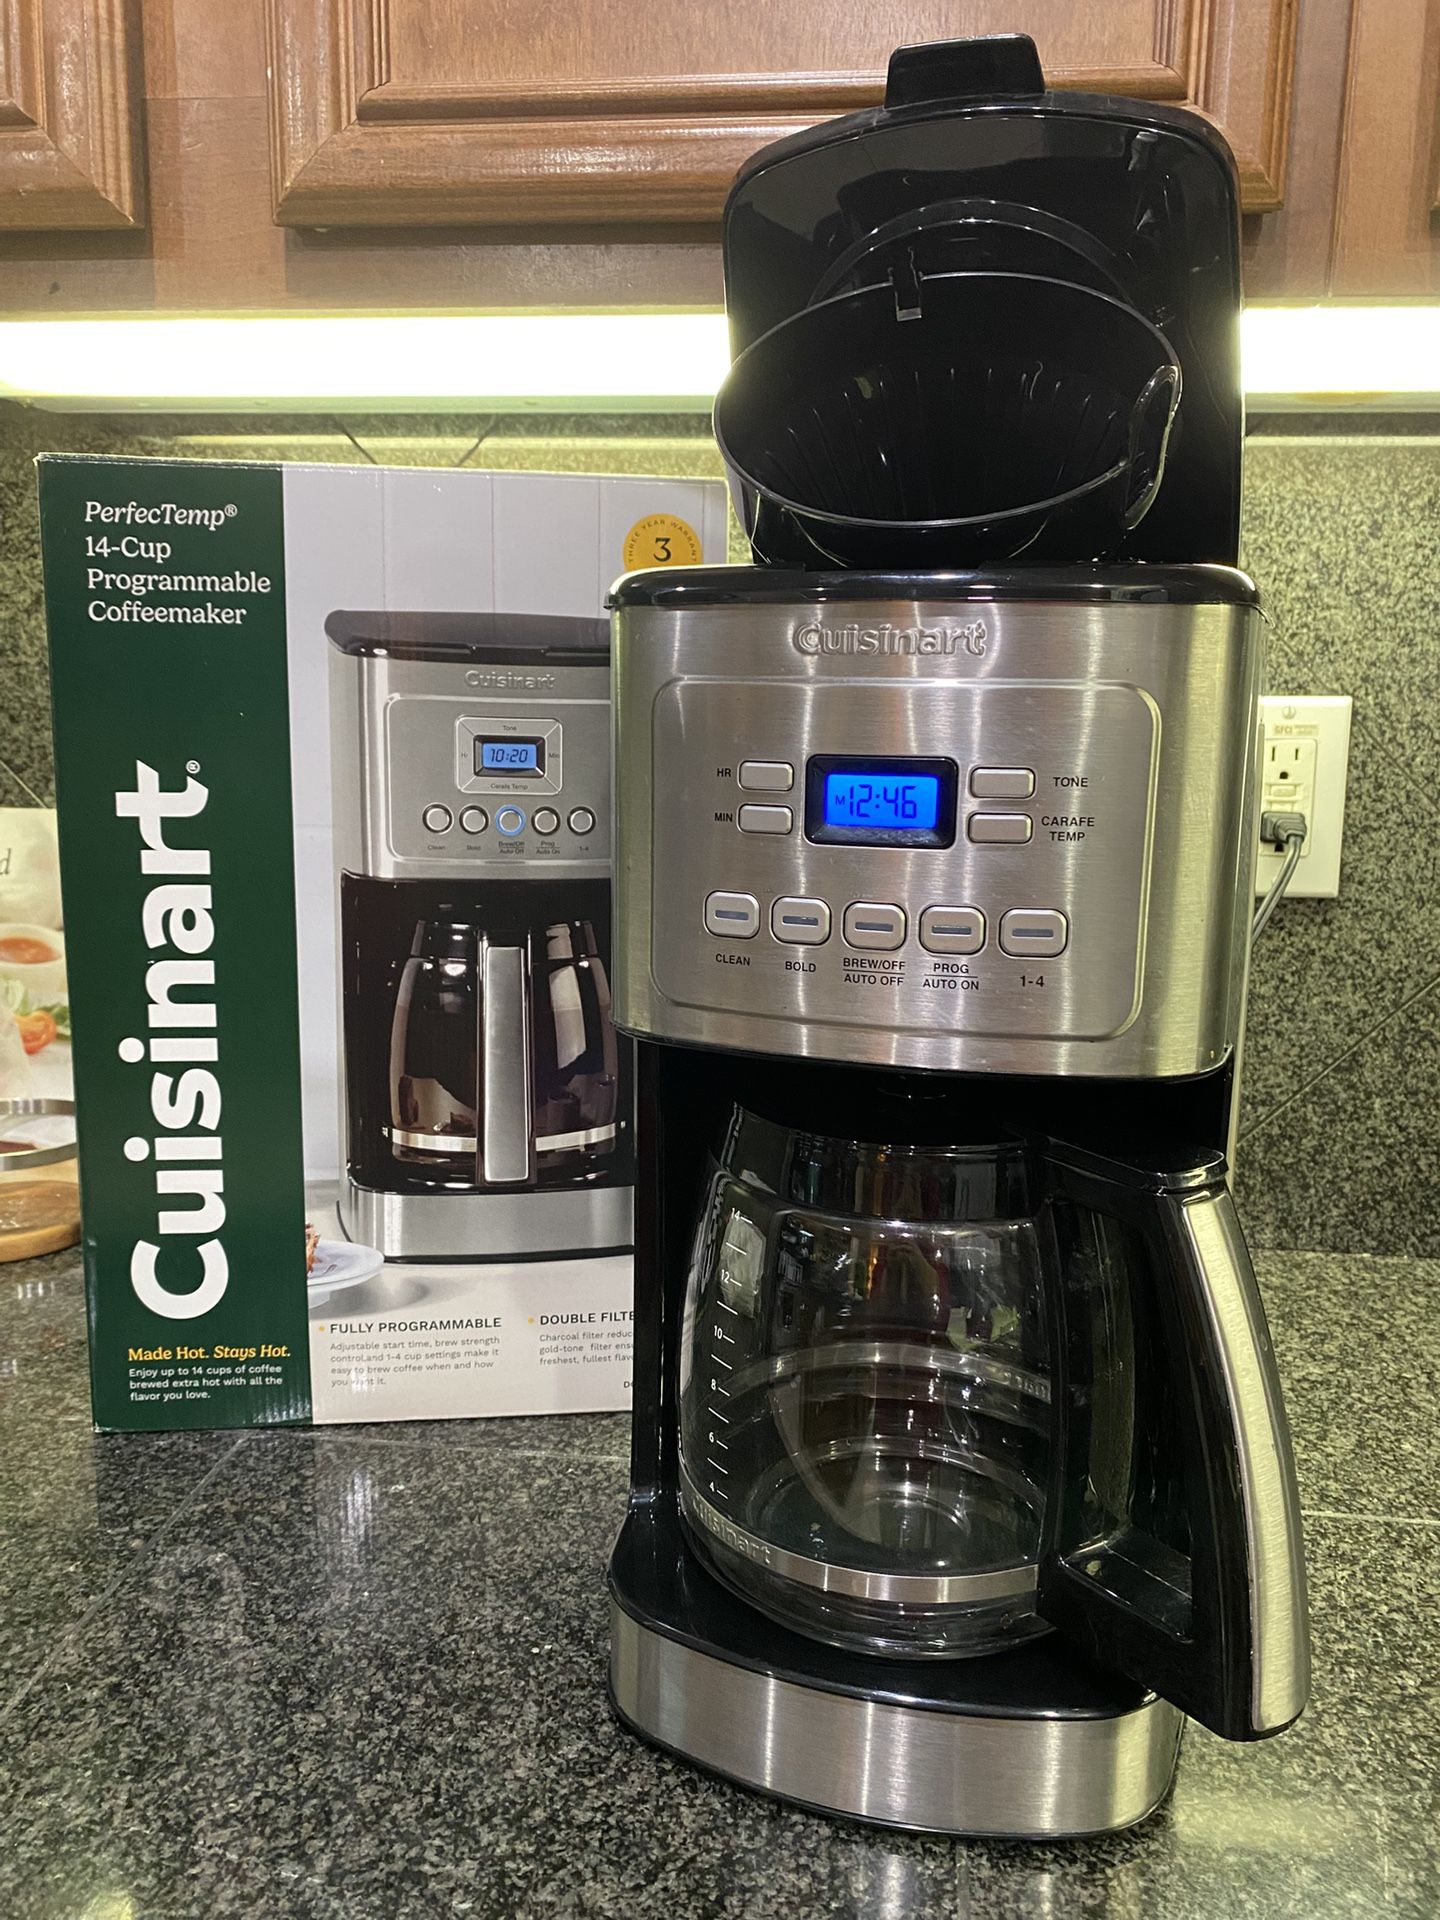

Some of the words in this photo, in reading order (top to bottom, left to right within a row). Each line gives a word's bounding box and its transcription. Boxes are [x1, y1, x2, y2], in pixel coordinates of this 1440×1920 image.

[84, 501, 238, 531] PerfecTemp®
[628, 532, 641, 563] THREE
[642, 519, 666, 530] YEAR
[85, 536, 171, 563] 14-Cup
[653, 537, 672, 562] 3
[87, 568, 271, 595] Programmable
[88, 600, 247, 624] Coffeemaker
[792, 619, 988, 657] Cuisinart
[464, 670, 556, 689] Cuisinart
[490, 748, 528, 763] 10:20
[717, 768, 732, 778] HR
[1053, 776, 1088, 788] TONE
[849, 784, 917, 819] 12:46
[714, 812, 733, 823] MIN
[1041, 816, 1095, 827] CARAFE
[1049, 831, 1085, 842] TEMP
[715, 953, 751, 966] CLEAN
[843, 957, 906, 970] BREW/OFF
[785, 961, 817, 973] BOLD
[933, 963, 969, 974] PROG
[844, 974, 877, 985] AUTO
[880, 976, 904, 986] OFF
[923, 978, 957, 989] AUTO
[961, 979, 979, 991] ON
[1020, 975, 1044, 987] 1-4
[731, 1208, 740, 1221] 14
[721, 1269, 730, 1284] 12
[540, 1312, 596, 1325] DOUBLE
[330, 1323, 374, 1334] FULLY
[378, 1317, 502, 1333] PROGRAMMABLE
[540, 1332, 580, 1342] Charcoal
[582, 1331, 604, 1340] filter
[714, 1325, 723, 1340] 10
[330, 1342, 380, 1352] Adjustable
[383, 1341, 405, 1349] start
[408, 1339, 433, 1349] time,
[435, 1339, 458, 1347] brew
[461, 1336, 500, 1346] strength
[539, 1345, 584, 1355] gold-tone
[590, 1342, 611, 1351] filter
[128, 1347, 173, 1361] Made
[176, 1346, 210, 1360] Hot.
[213, 1345, 257, 1361] Stays
[260, 1344, 291, 1358] Hot.
[387, 1353, 401, 1361] 1-4
[404, 1353, 422, 1361] cup
[425, 1350, 461, 1359] settings
[464, 1348, 489, 1357] make
[492, 1348, 499, 1356] it
[540, 1356, 580, 1365] freshest,
[582, 1354, 611, 1363] fullest
[129, 1368, 158, 1378] Enjoy
[161, 1368, 175, 1377] up
[178, 1367, 189, 1376] to
[191, 1366, 202, 1375] 14
[206, 1366, 232, 1377] cups
[235, 1365, 246, 1374] of
[248, 1364, 282, 1374] coffee
[331, 1367, 352, 1376] easy
[367, 1366, 391, 1374] brew
[393, 1364, 423, 1372] coffee
[425, 1363, 451, 1371] when
[454, 1361, 471, 1369] and
[129, 1379, 169, 1389] brewed
[172, 1379, 199, 1388] extra
[202, 1377, 220, 1387] hot
[223, 1376, 246, 1386] with
[249, 1376, 263, 1385] all
[264, 1376, 283, 1385] the
[331, 1379, 348, 1388] you
[377, 1376, 386, 1385] it.
[710, 1378, 717, 1391] 8
[130, 1391, 160, 1401] flavor
[163, 1392, 183, 1402] you
[185, 1389, 212, 1399] love.
[709, 1431, 715, 1443] 6
[709, 1481, 715, 1492] 4
[692, 1494, 771, 1565] Cuisinart
